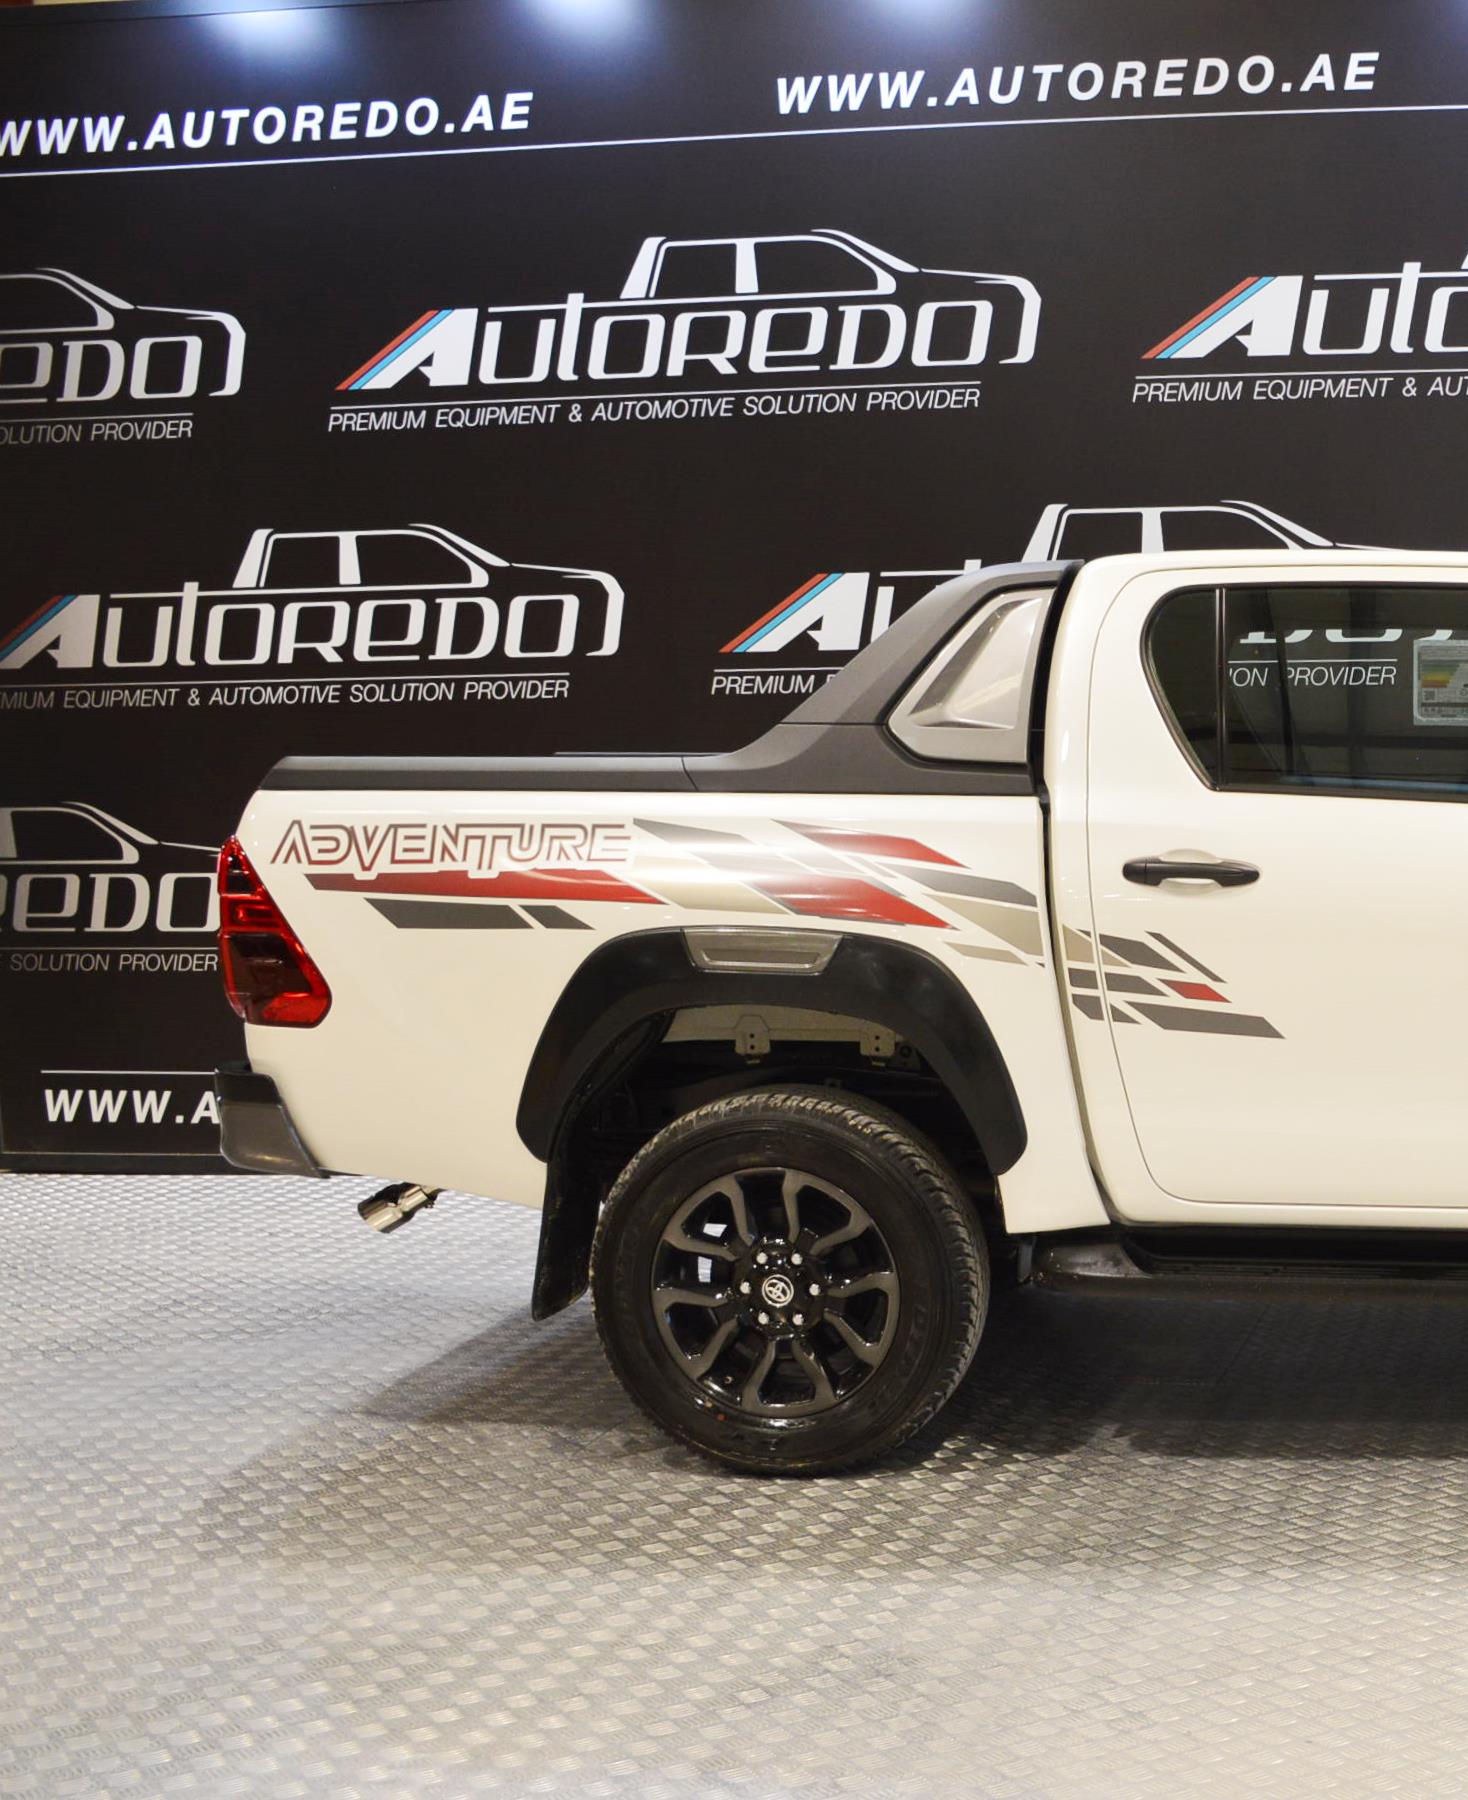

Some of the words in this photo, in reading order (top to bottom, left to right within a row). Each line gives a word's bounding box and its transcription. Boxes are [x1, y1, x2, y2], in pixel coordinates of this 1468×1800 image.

[777, 52, 1380, 115] WWW.AUTOREDO.AE
[1132, 381, 1242, 403] PREMIUM
[1253, 378, 1394, 400] EQUIPMENT
[1402, 377, 1417, 397] &
[328, 410, 426, 432] PREMIUM
[435, 405, 560, 428] EQUIPMENT
[568, 404, 582, 422] &
[592, 397, 735, 423] AUTOMOTIVE
[743, 393, 857, 416] SOLUTION
[867, 389, 980, 412] PROVIDER
[91, 420, 193, 441] PROVIDER
[63, 688, 181, 709] EQUIPMENT
[188, 687, 201, 706] &
[209, 685, 342, 707] AUTOMOTIVE
[349, 682, 455, 703] SOLUTION
[463, 680, 569, 701] PROVIDER
[711, 674, 815, 695] PREMIUM
[270, 819, 632, 871] ADVENTURE
[10, 953, 110, 972] SOLUTION
[118, 953, 218, 972] PROVIDER
